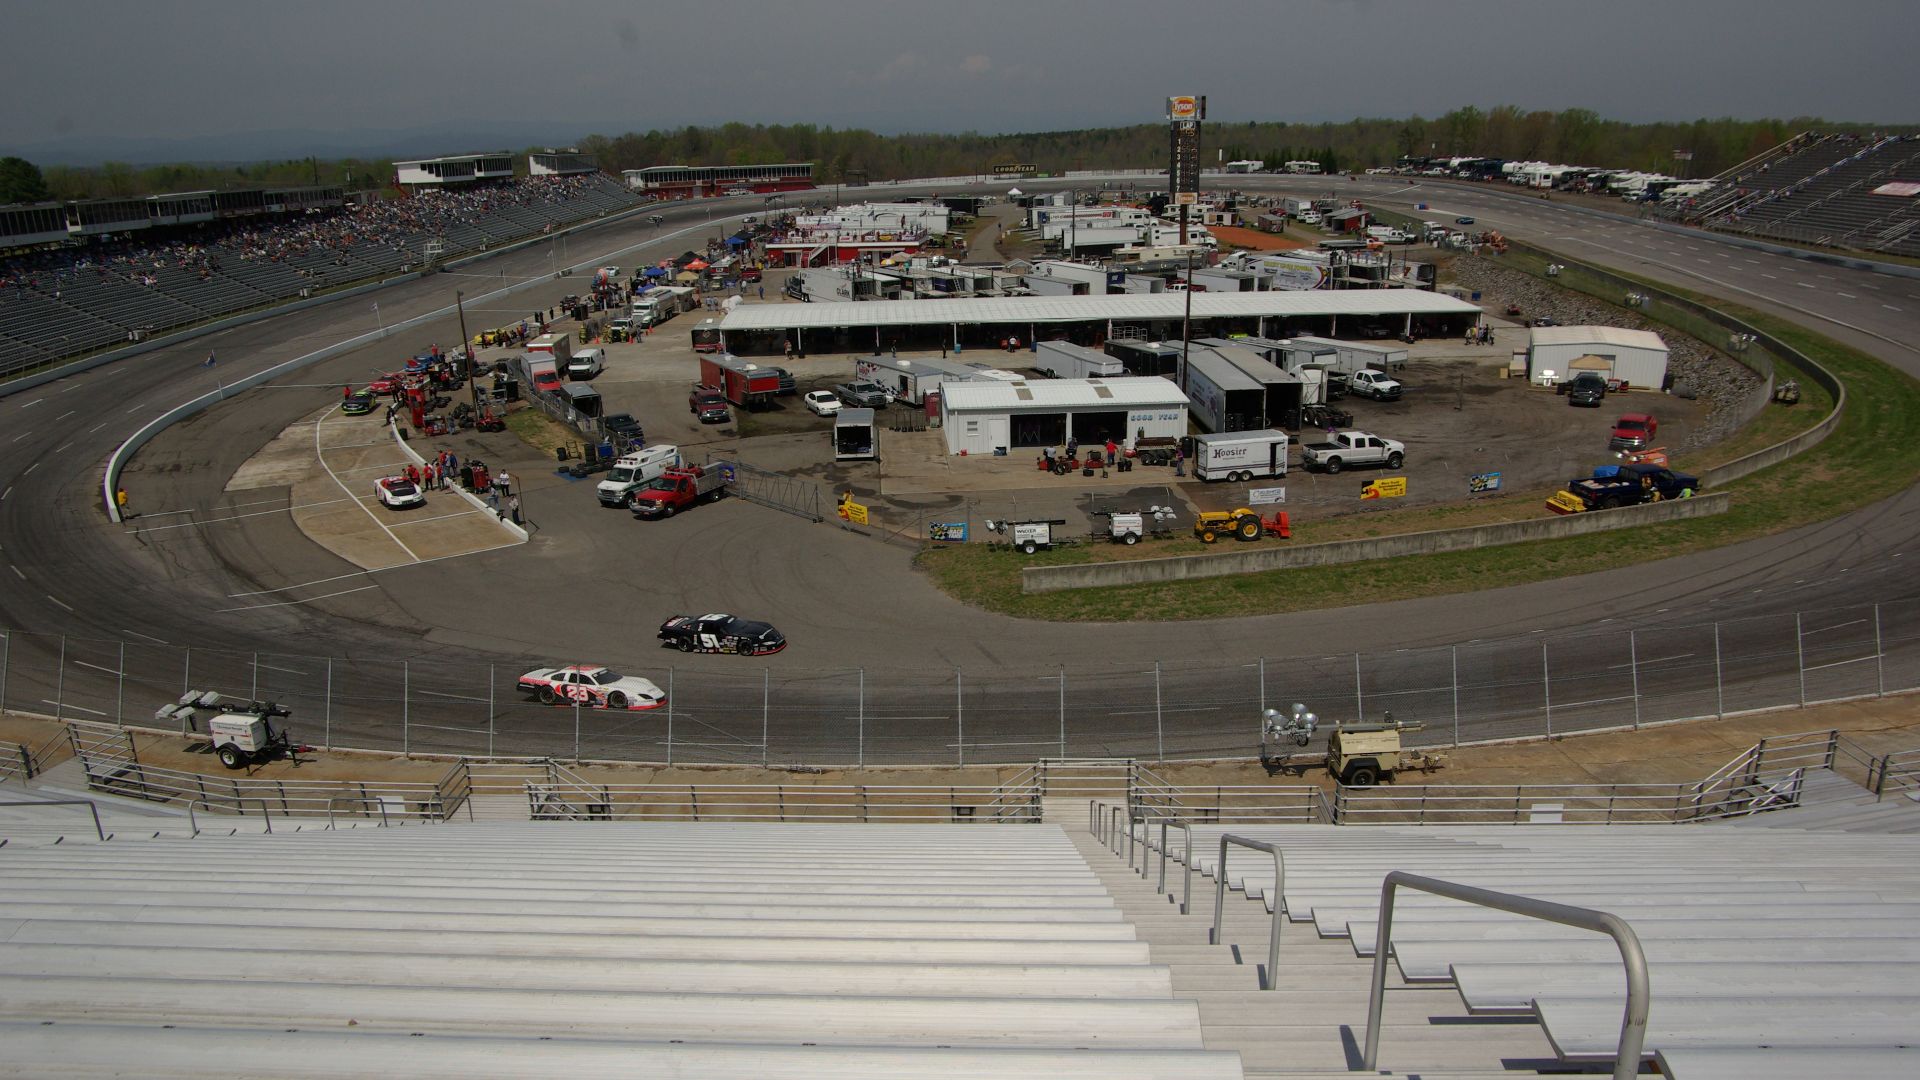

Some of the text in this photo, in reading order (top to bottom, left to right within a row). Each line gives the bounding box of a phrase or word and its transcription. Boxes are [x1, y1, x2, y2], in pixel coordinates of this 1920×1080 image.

[1173, 102, 1193, 112] Tyson
[1212, 447, 1247, 458] Hoosier
[700, 634, 720, 648] 51
[566, 685, 588, 701] 23
